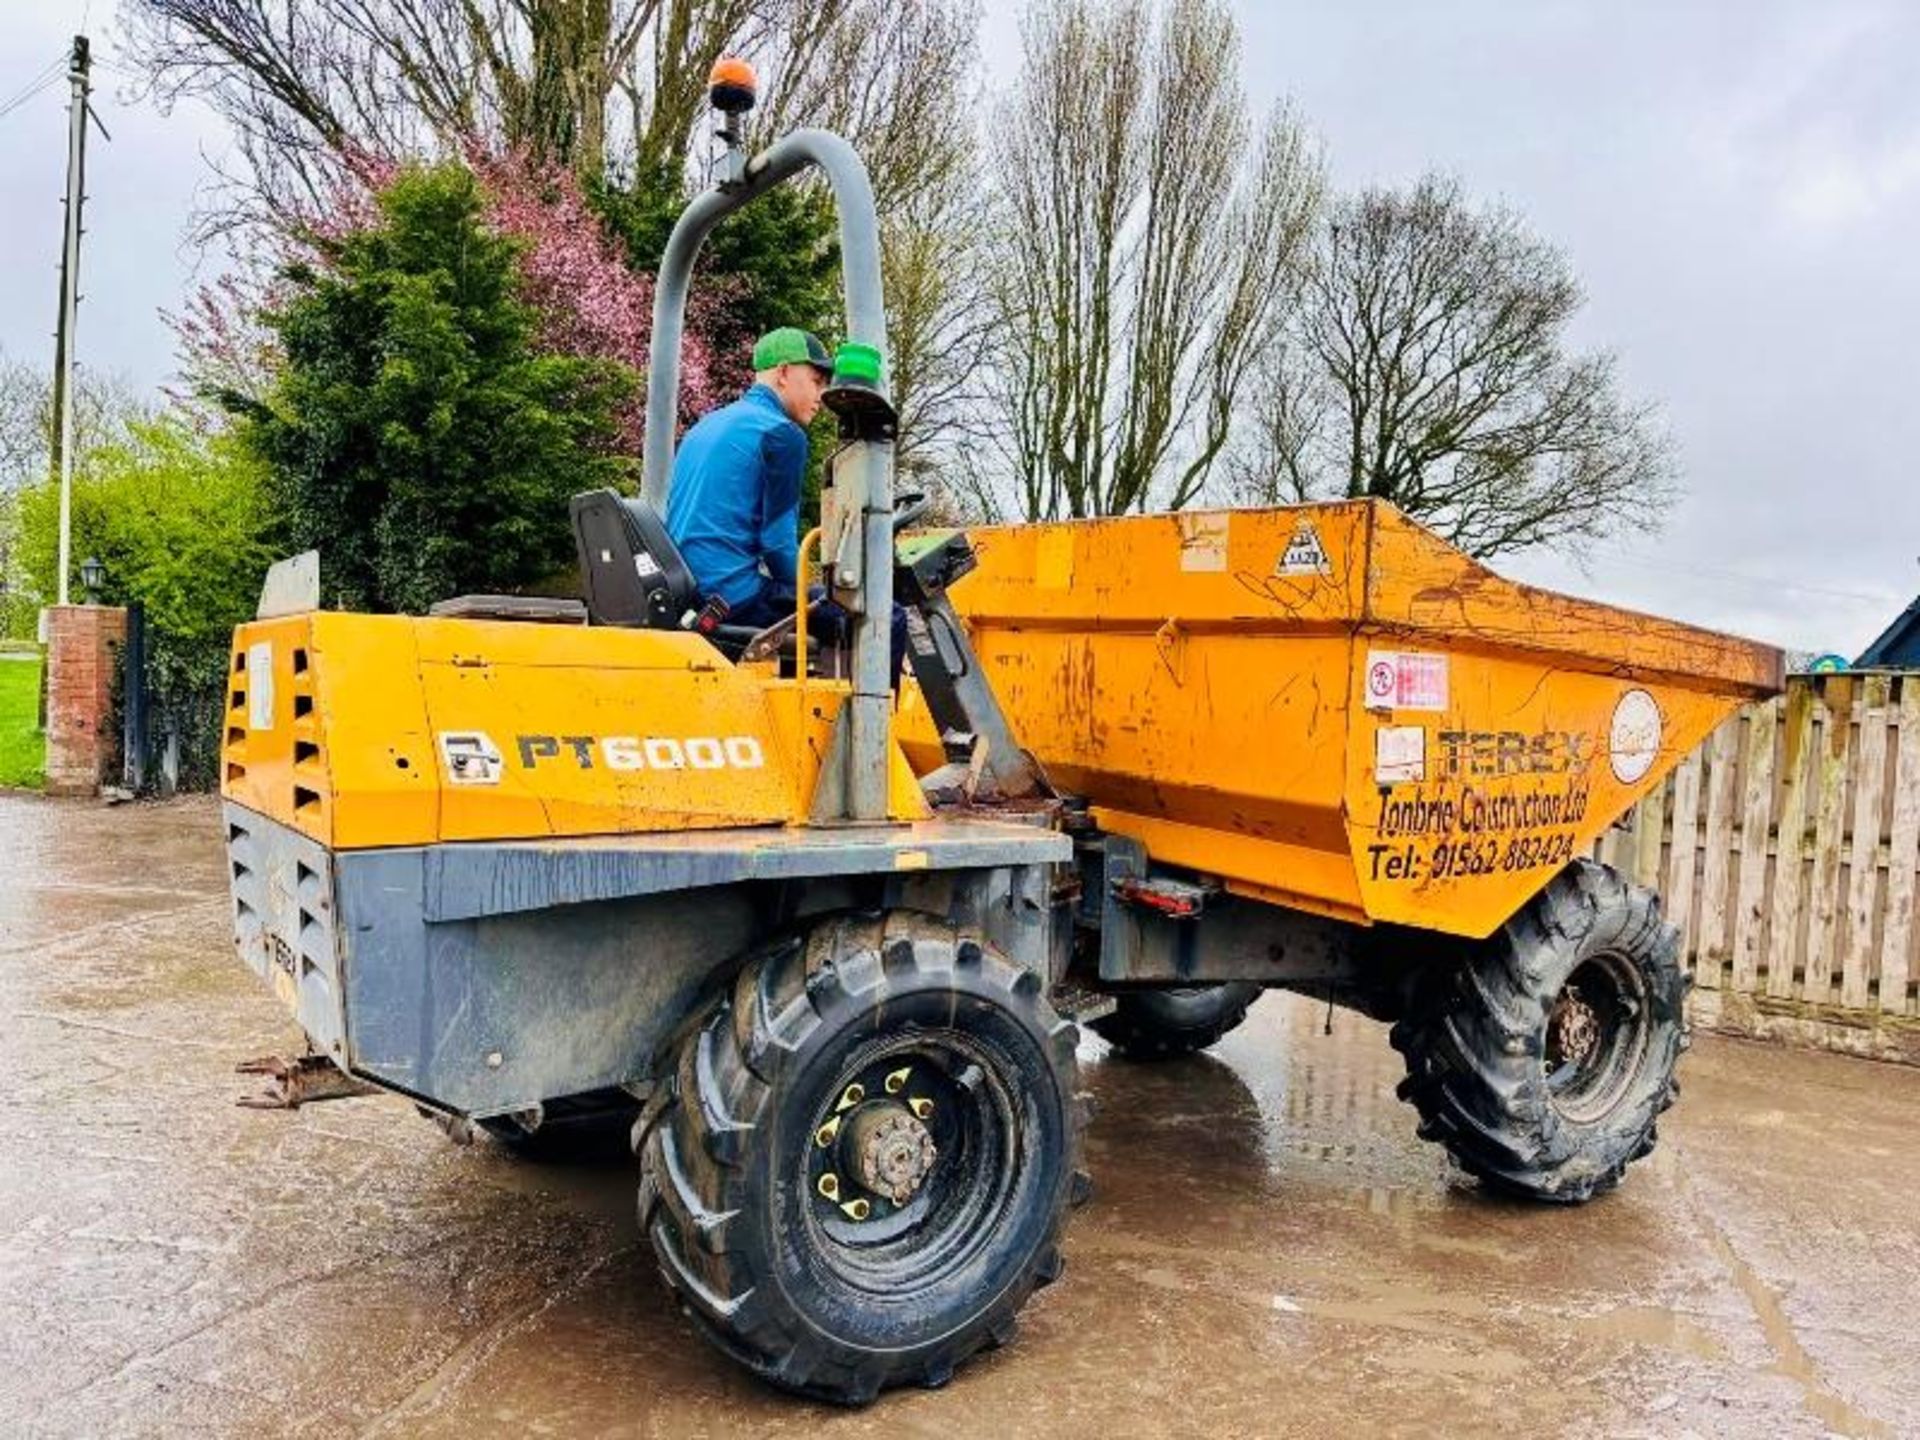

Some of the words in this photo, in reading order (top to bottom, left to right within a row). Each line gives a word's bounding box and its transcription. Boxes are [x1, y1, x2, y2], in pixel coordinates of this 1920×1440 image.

[516, 735, 764, 770] PT6000
[1438, 731, 1588, 774] TEREX
[1367, 844, 1422, 882] Tel:
